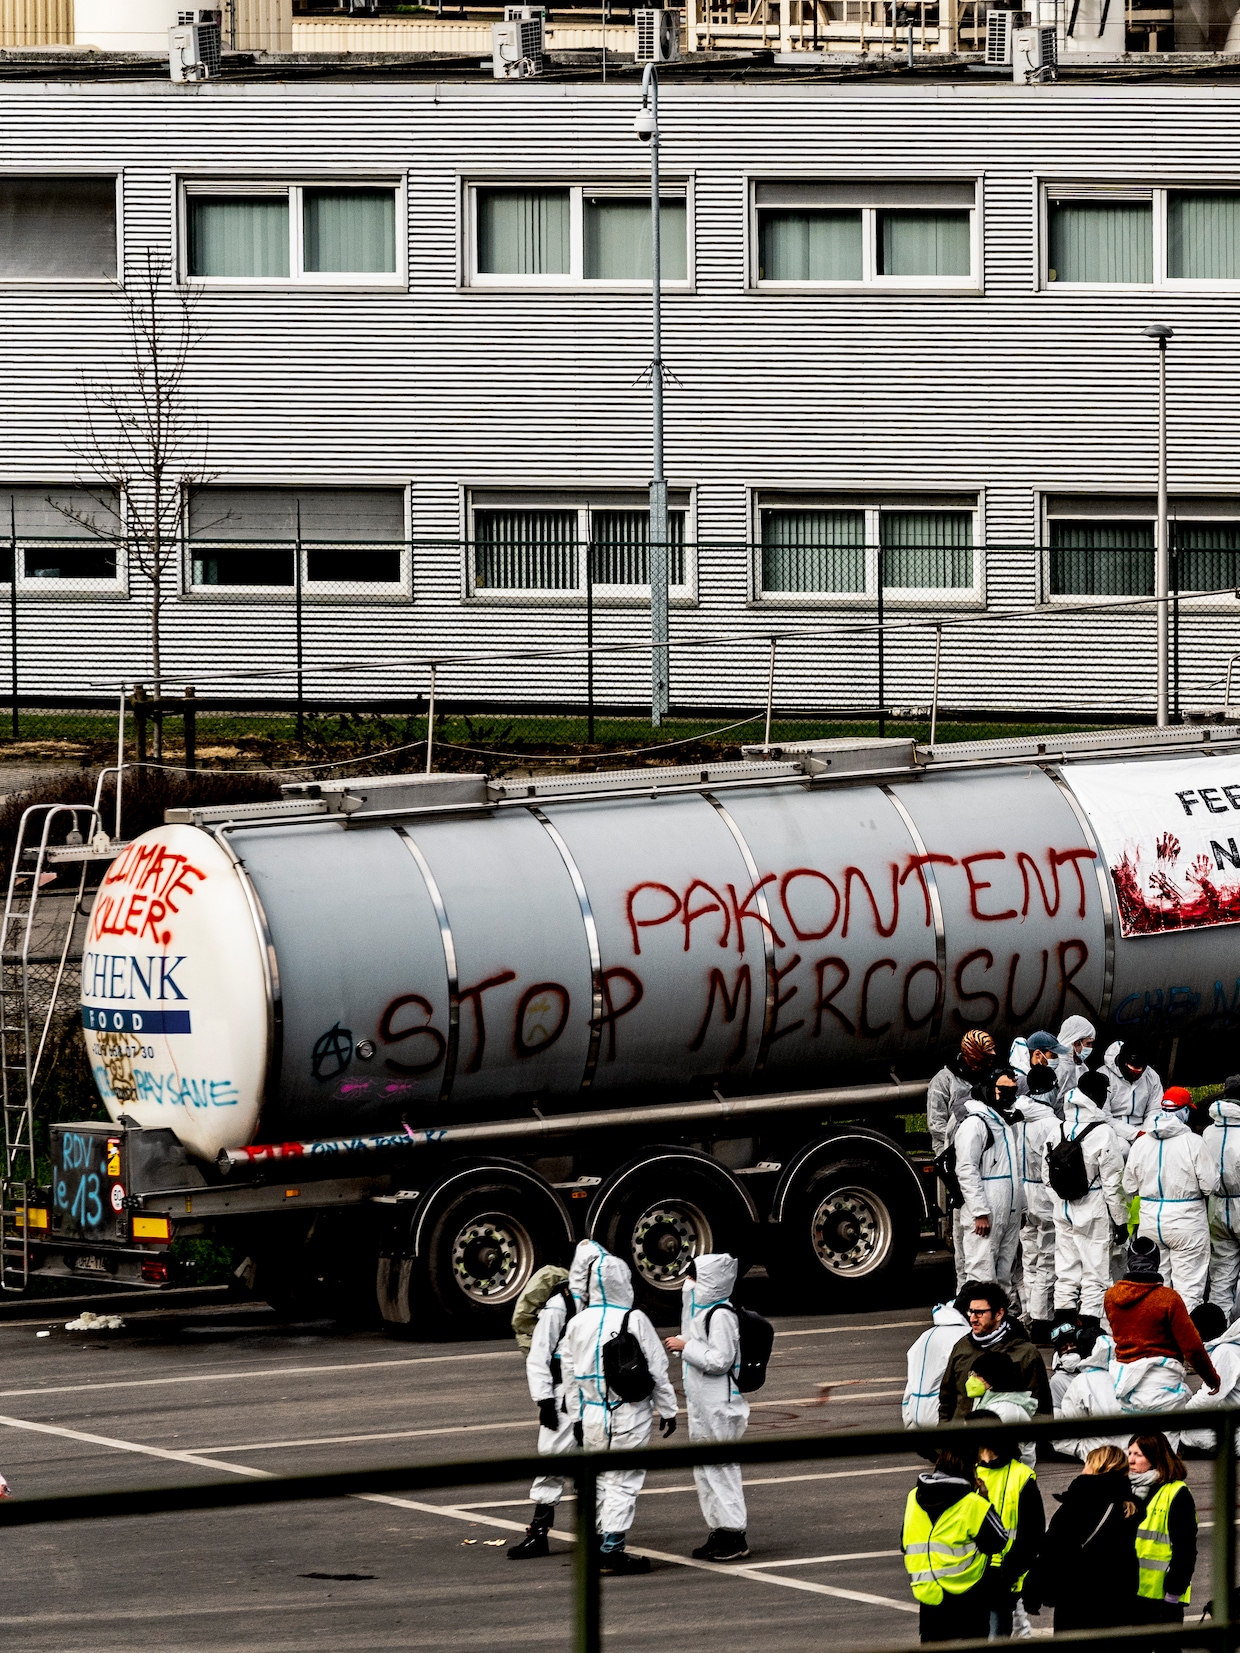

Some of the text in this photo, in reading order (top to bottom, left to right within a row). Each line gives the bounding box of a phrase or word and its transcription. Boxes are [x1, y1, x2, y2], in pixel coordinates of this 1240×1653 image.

[105, 843, 207, 914] CLIMATE
[627, 848, 1097, 956] PAKONTENT
[89, 1010, 143, 1031] FOOD
[380, 967, 643, 1074] STOP
[690, 938, 1100, 1066] MERCOSUR
[140, 1046, 154, 1059] 30
[62, 1132, 93, 1170] RDV
[53, 1165, 102, 1227] le 13
